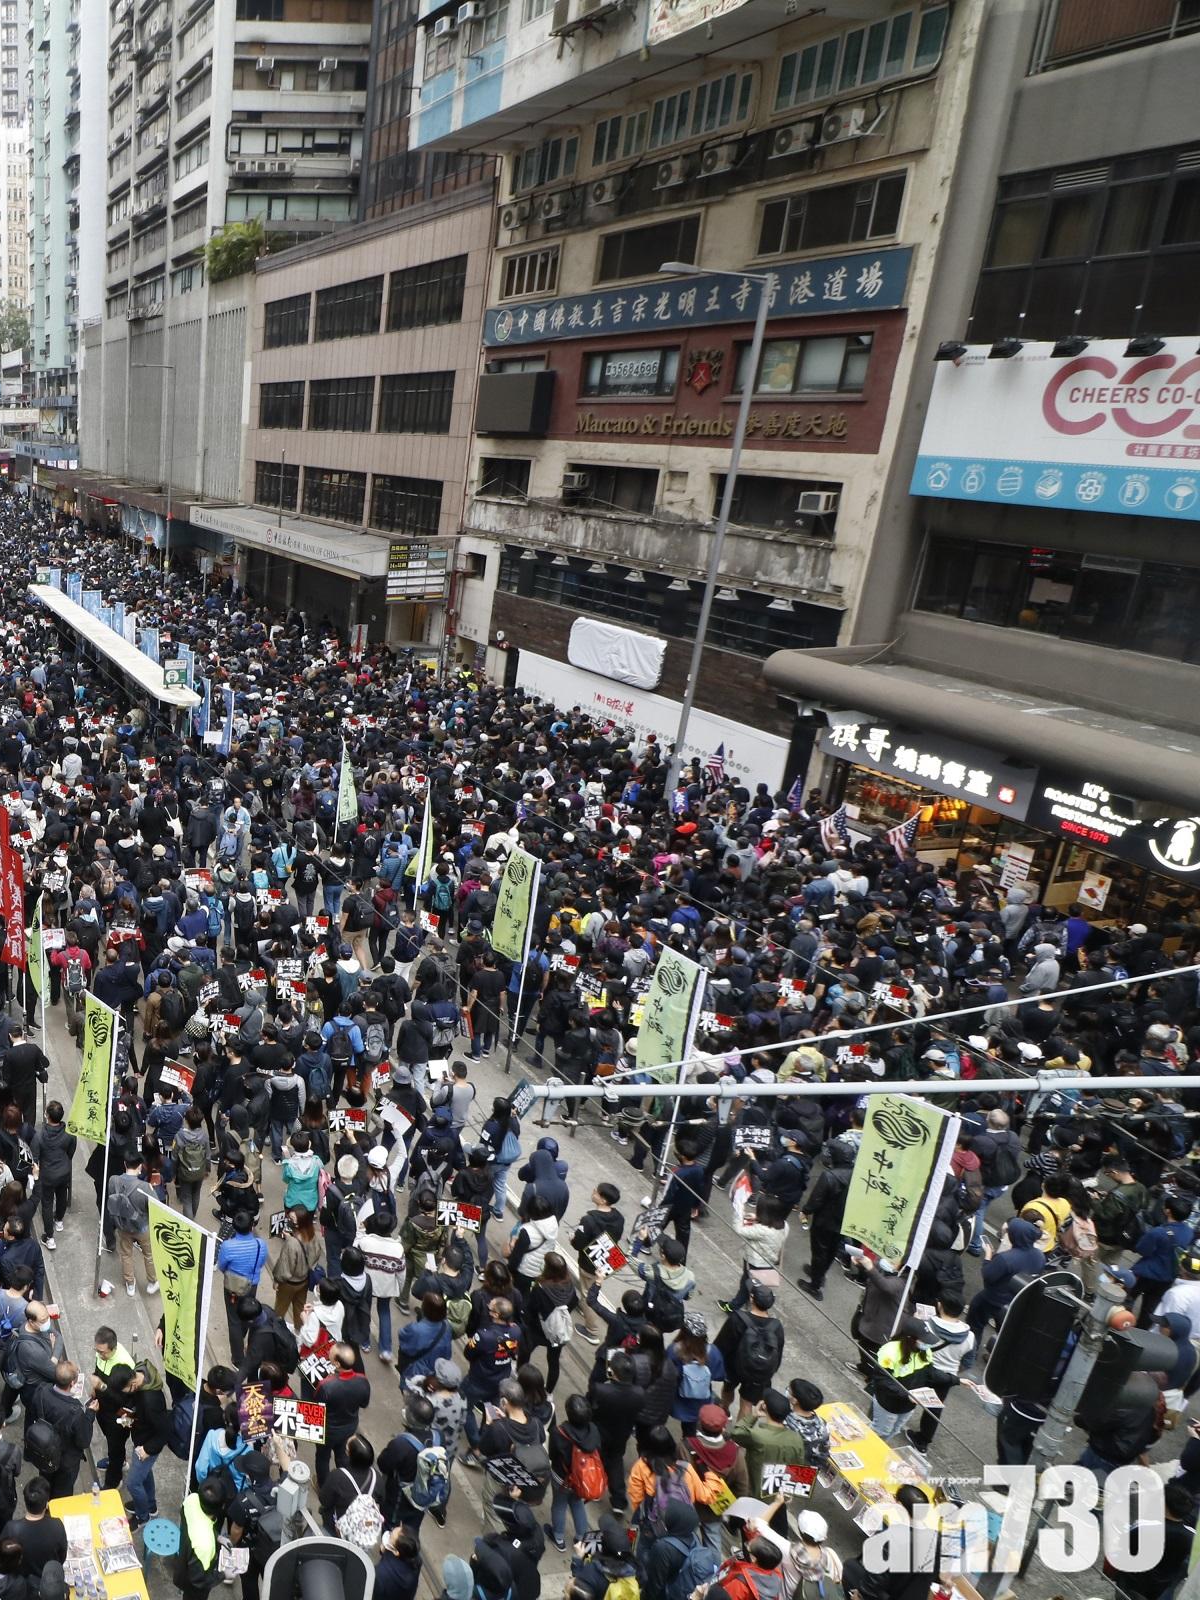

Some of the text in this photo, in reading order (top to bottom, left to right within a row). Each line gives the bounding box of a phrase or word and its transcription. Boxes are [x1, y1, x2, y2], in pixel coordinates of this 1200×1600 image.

[1069, 386, 1150, 404] CHEERS
[575, 411, 733, 438] Marcato & Friends
[323, 549, 340, 561] CHINA
[1060, 820, 1089, 837] SINCE
[735, 1127, 771, 1136] 五大訴求
